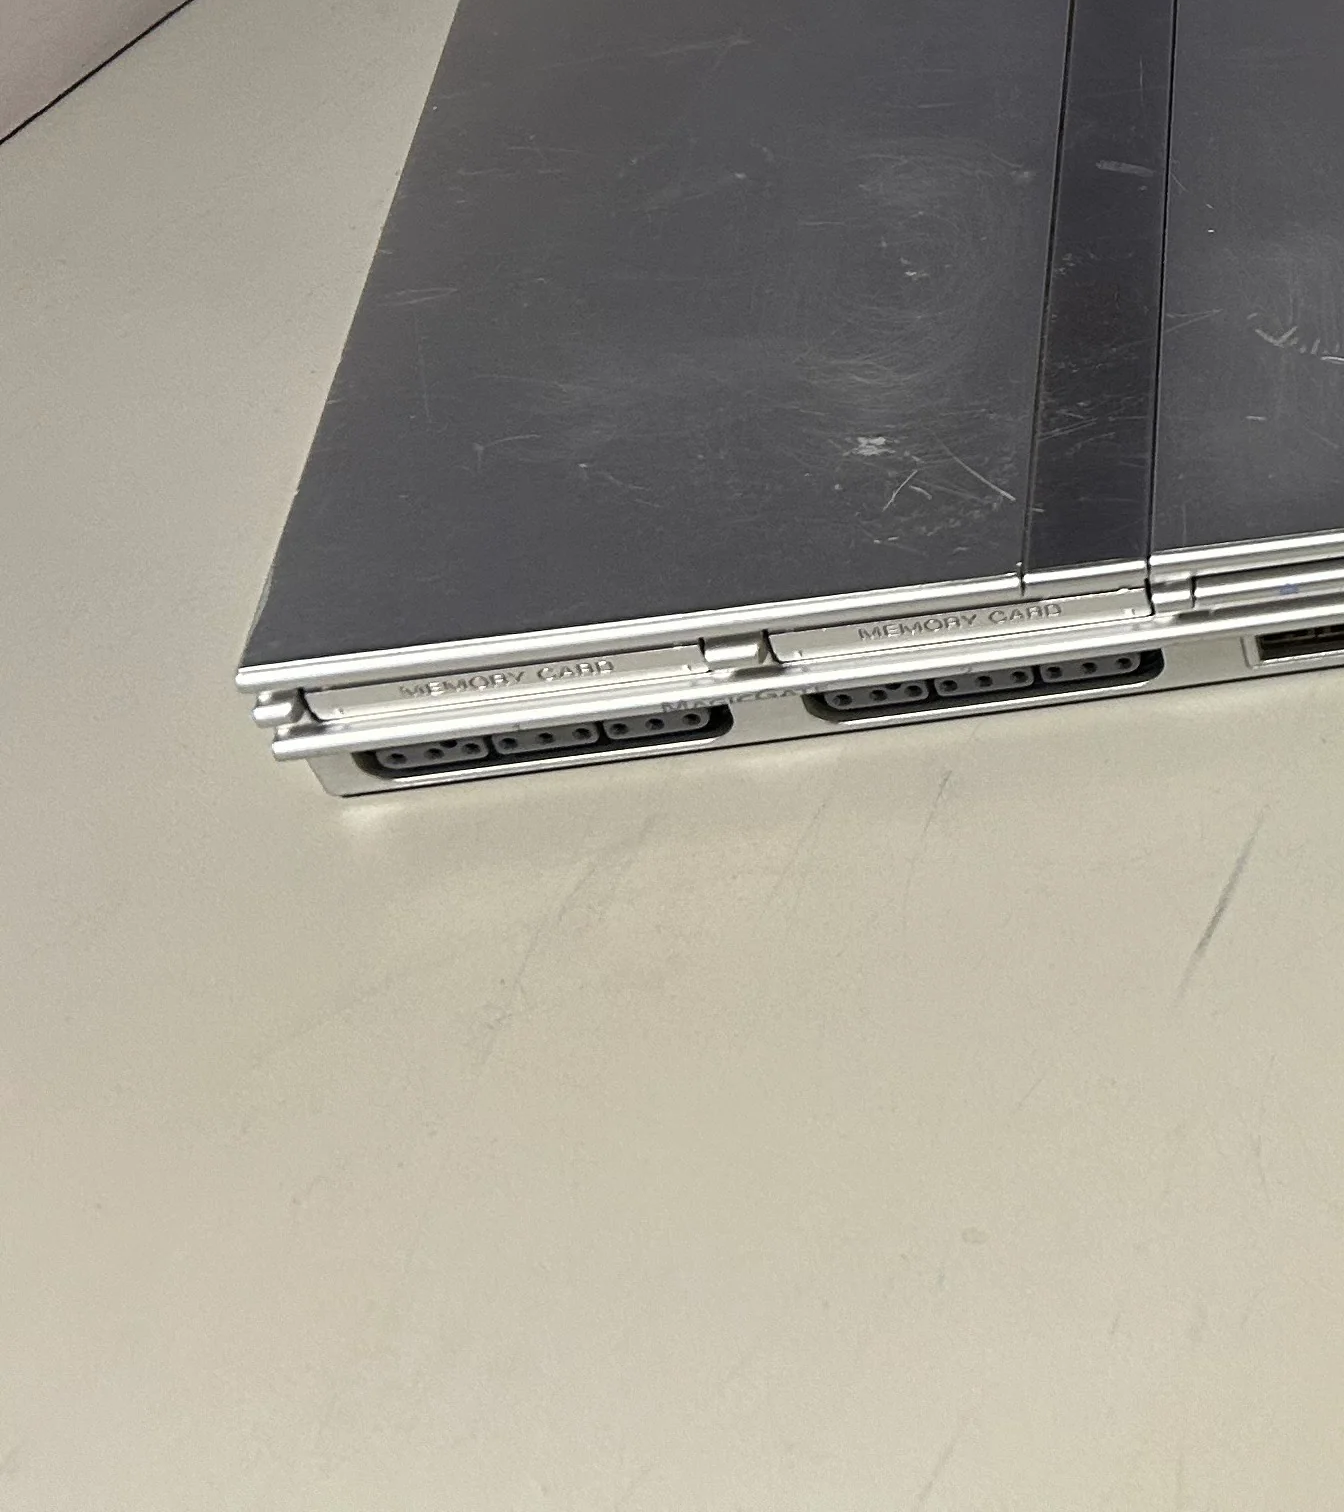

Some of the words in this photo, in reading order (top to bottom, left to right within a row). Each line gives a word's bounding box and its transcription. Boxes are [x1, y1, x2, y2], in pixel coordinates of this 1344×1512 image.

[857, 612, 978, 642] MEMORY
[987, 601, 1063, 624] CARD
[398, 666, 526, 699] MEMORY
[536, 659, 615, 683] CARD
